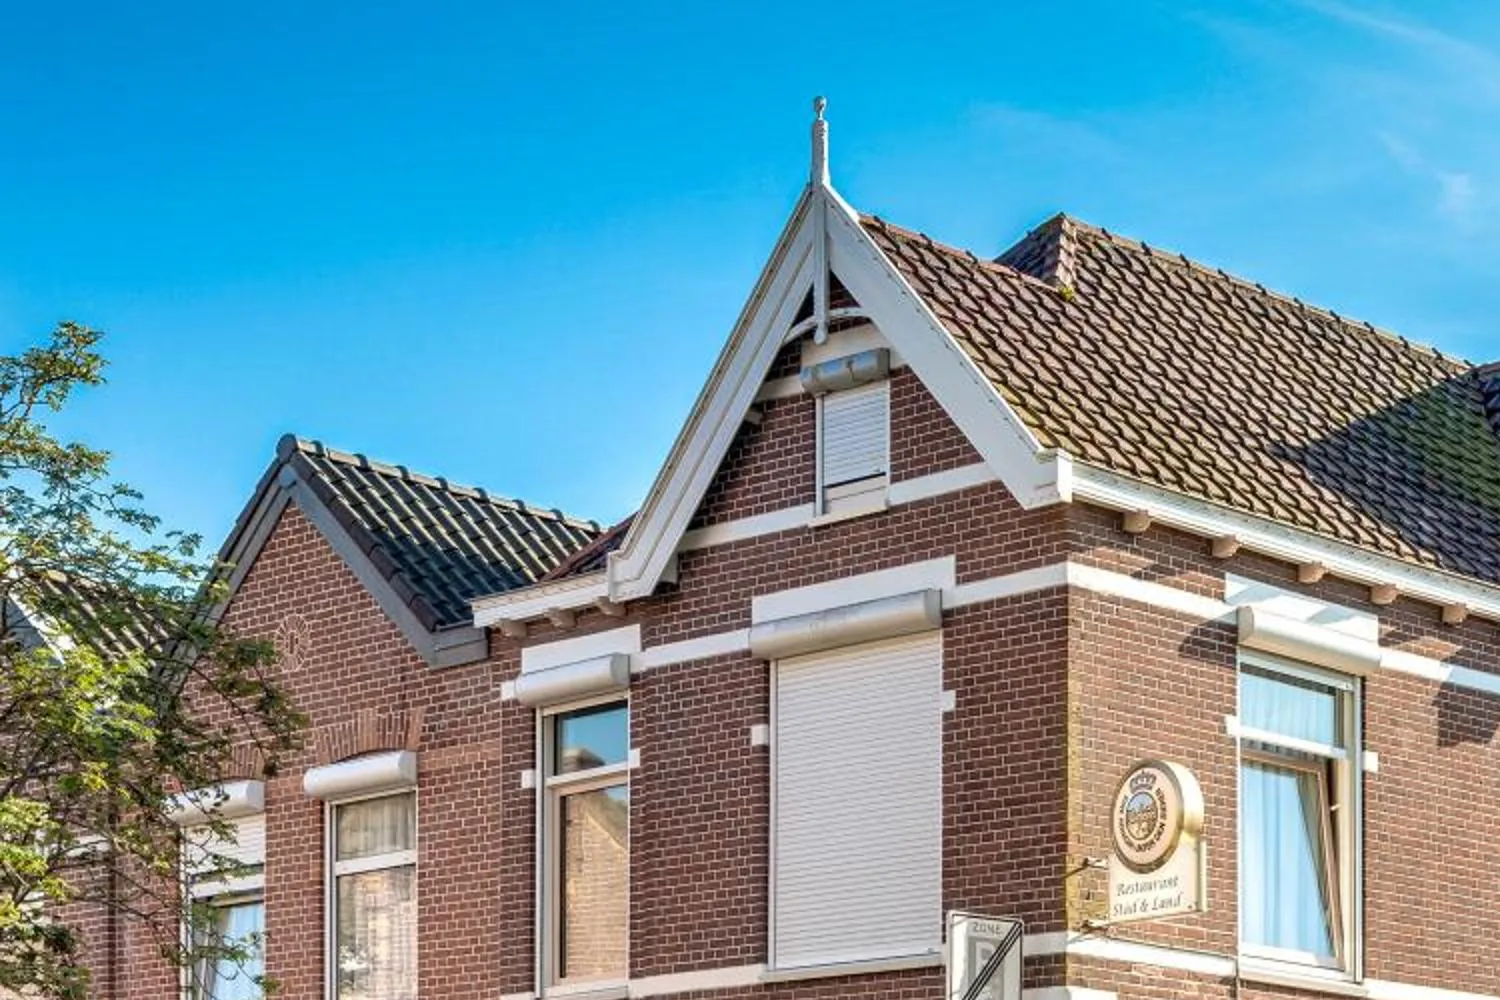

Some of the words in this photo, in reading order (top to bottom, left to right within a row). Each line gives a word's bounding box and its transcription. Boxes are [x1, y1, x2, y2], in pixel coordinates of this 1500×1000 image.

[1140, 899, 1149, 912] &
[1152, 893, 1183, 911] Land
[973, 921, 1002, 934] ZONE
